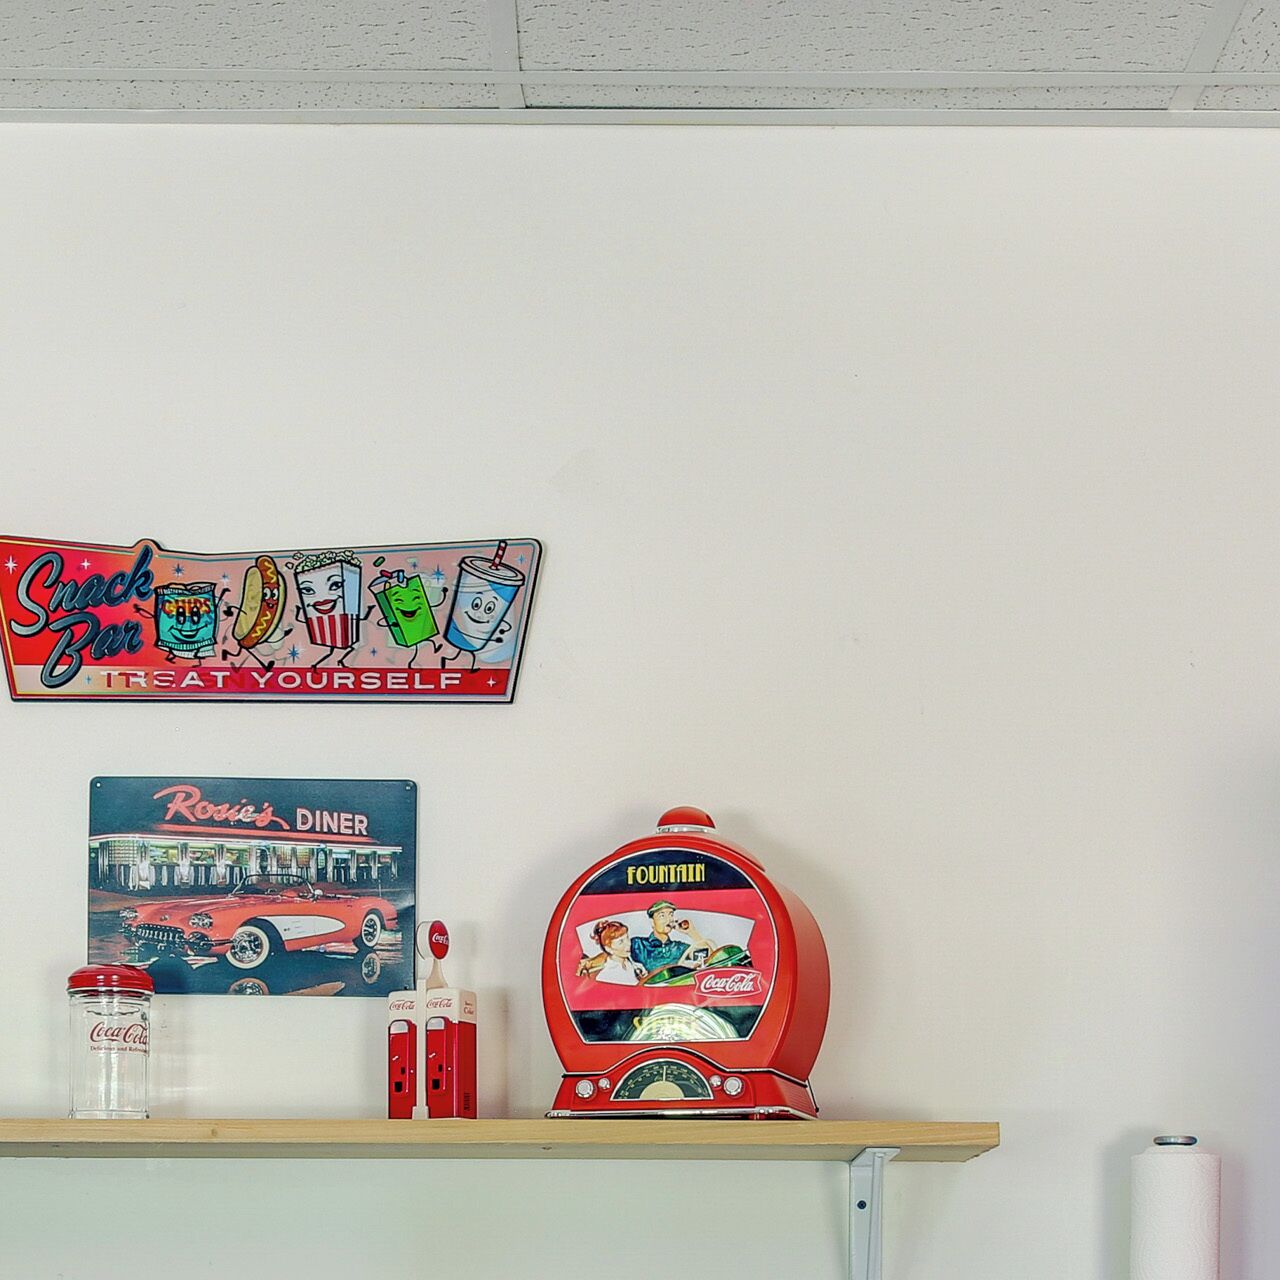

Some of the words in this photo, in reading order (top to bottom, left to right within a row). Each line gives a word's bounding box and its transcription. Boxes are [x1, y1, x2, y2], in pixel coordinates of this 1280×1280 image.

[10, 544, 155, 638] Snack
[40, 612, 144, 688] Bar
[257, 670, 463, 690] YOURSELF
[153, 784, 290, 830] Rosie's
[296, 807, 369, 836] DINER
[627, 862, 705, 885] FOUNTAIN
[700, 972, 755, 993] Coca-Cola
